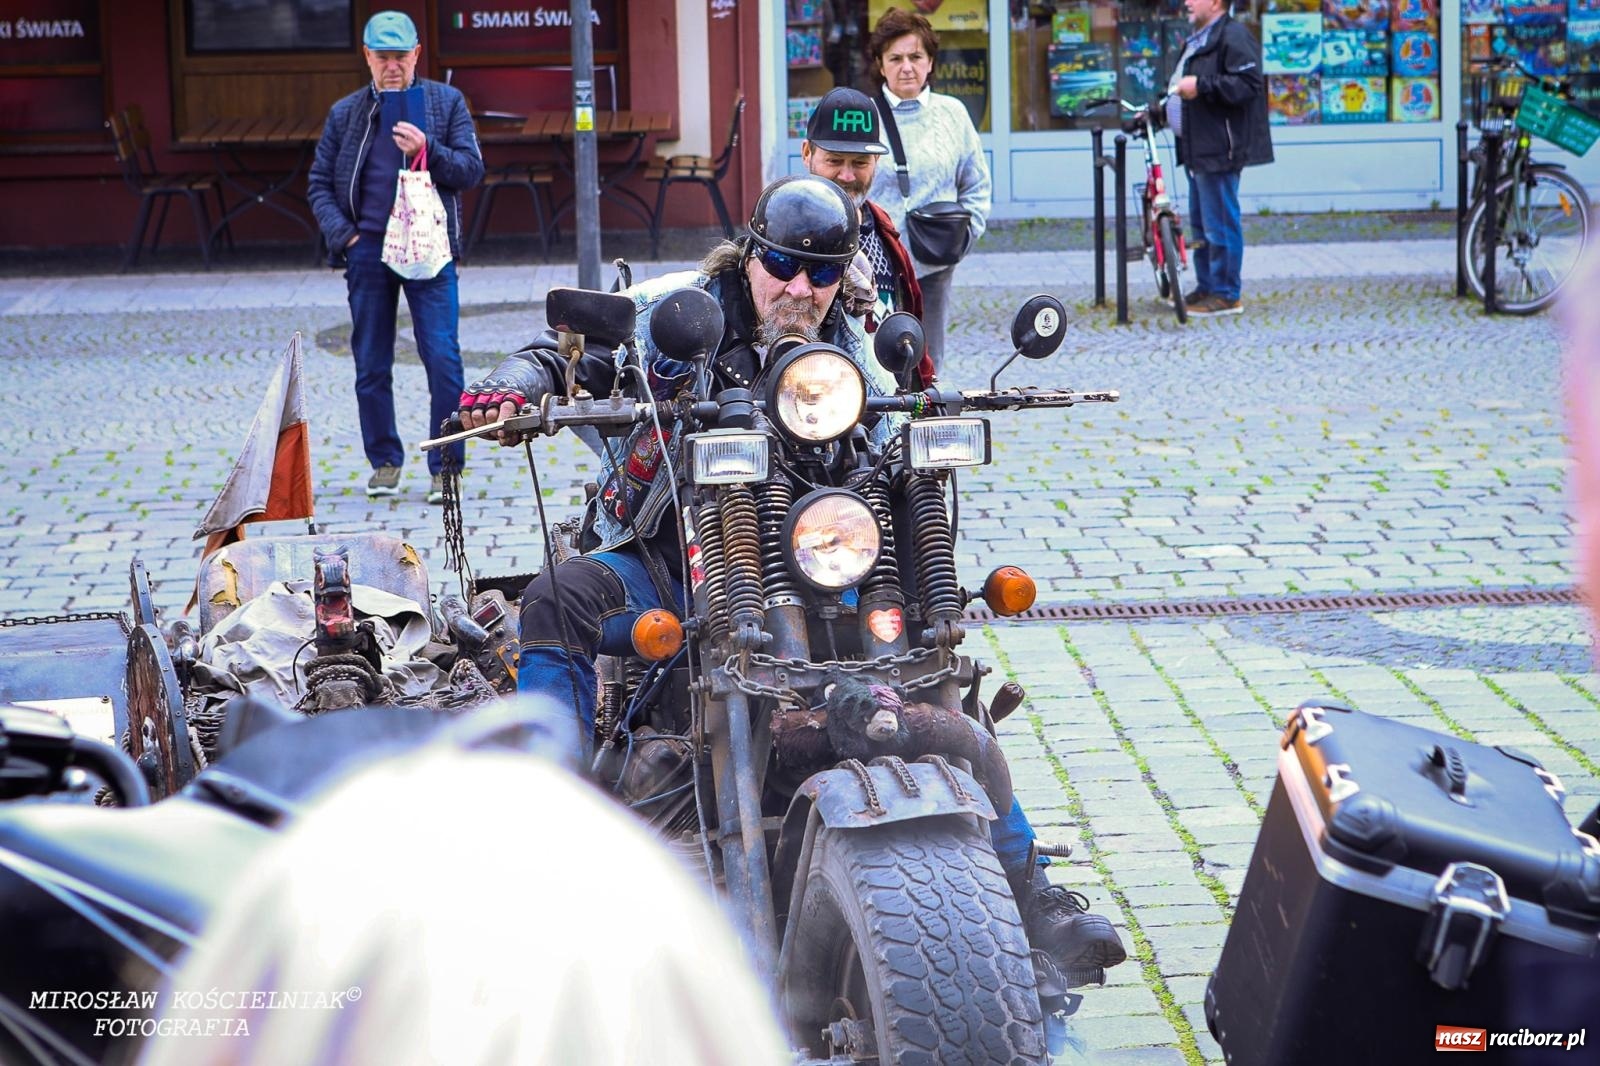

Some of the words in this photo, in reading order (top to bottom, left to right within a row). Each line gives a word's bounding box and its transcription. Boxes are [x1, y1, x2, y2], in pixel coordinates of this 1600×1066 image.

[15, 16, 85, 39] ŚWIATA
[472, 10, 530, 28] SMAKI
[534, 6, 601, 27] ŚWIA
[935, 61, 985, 82] Witaj
